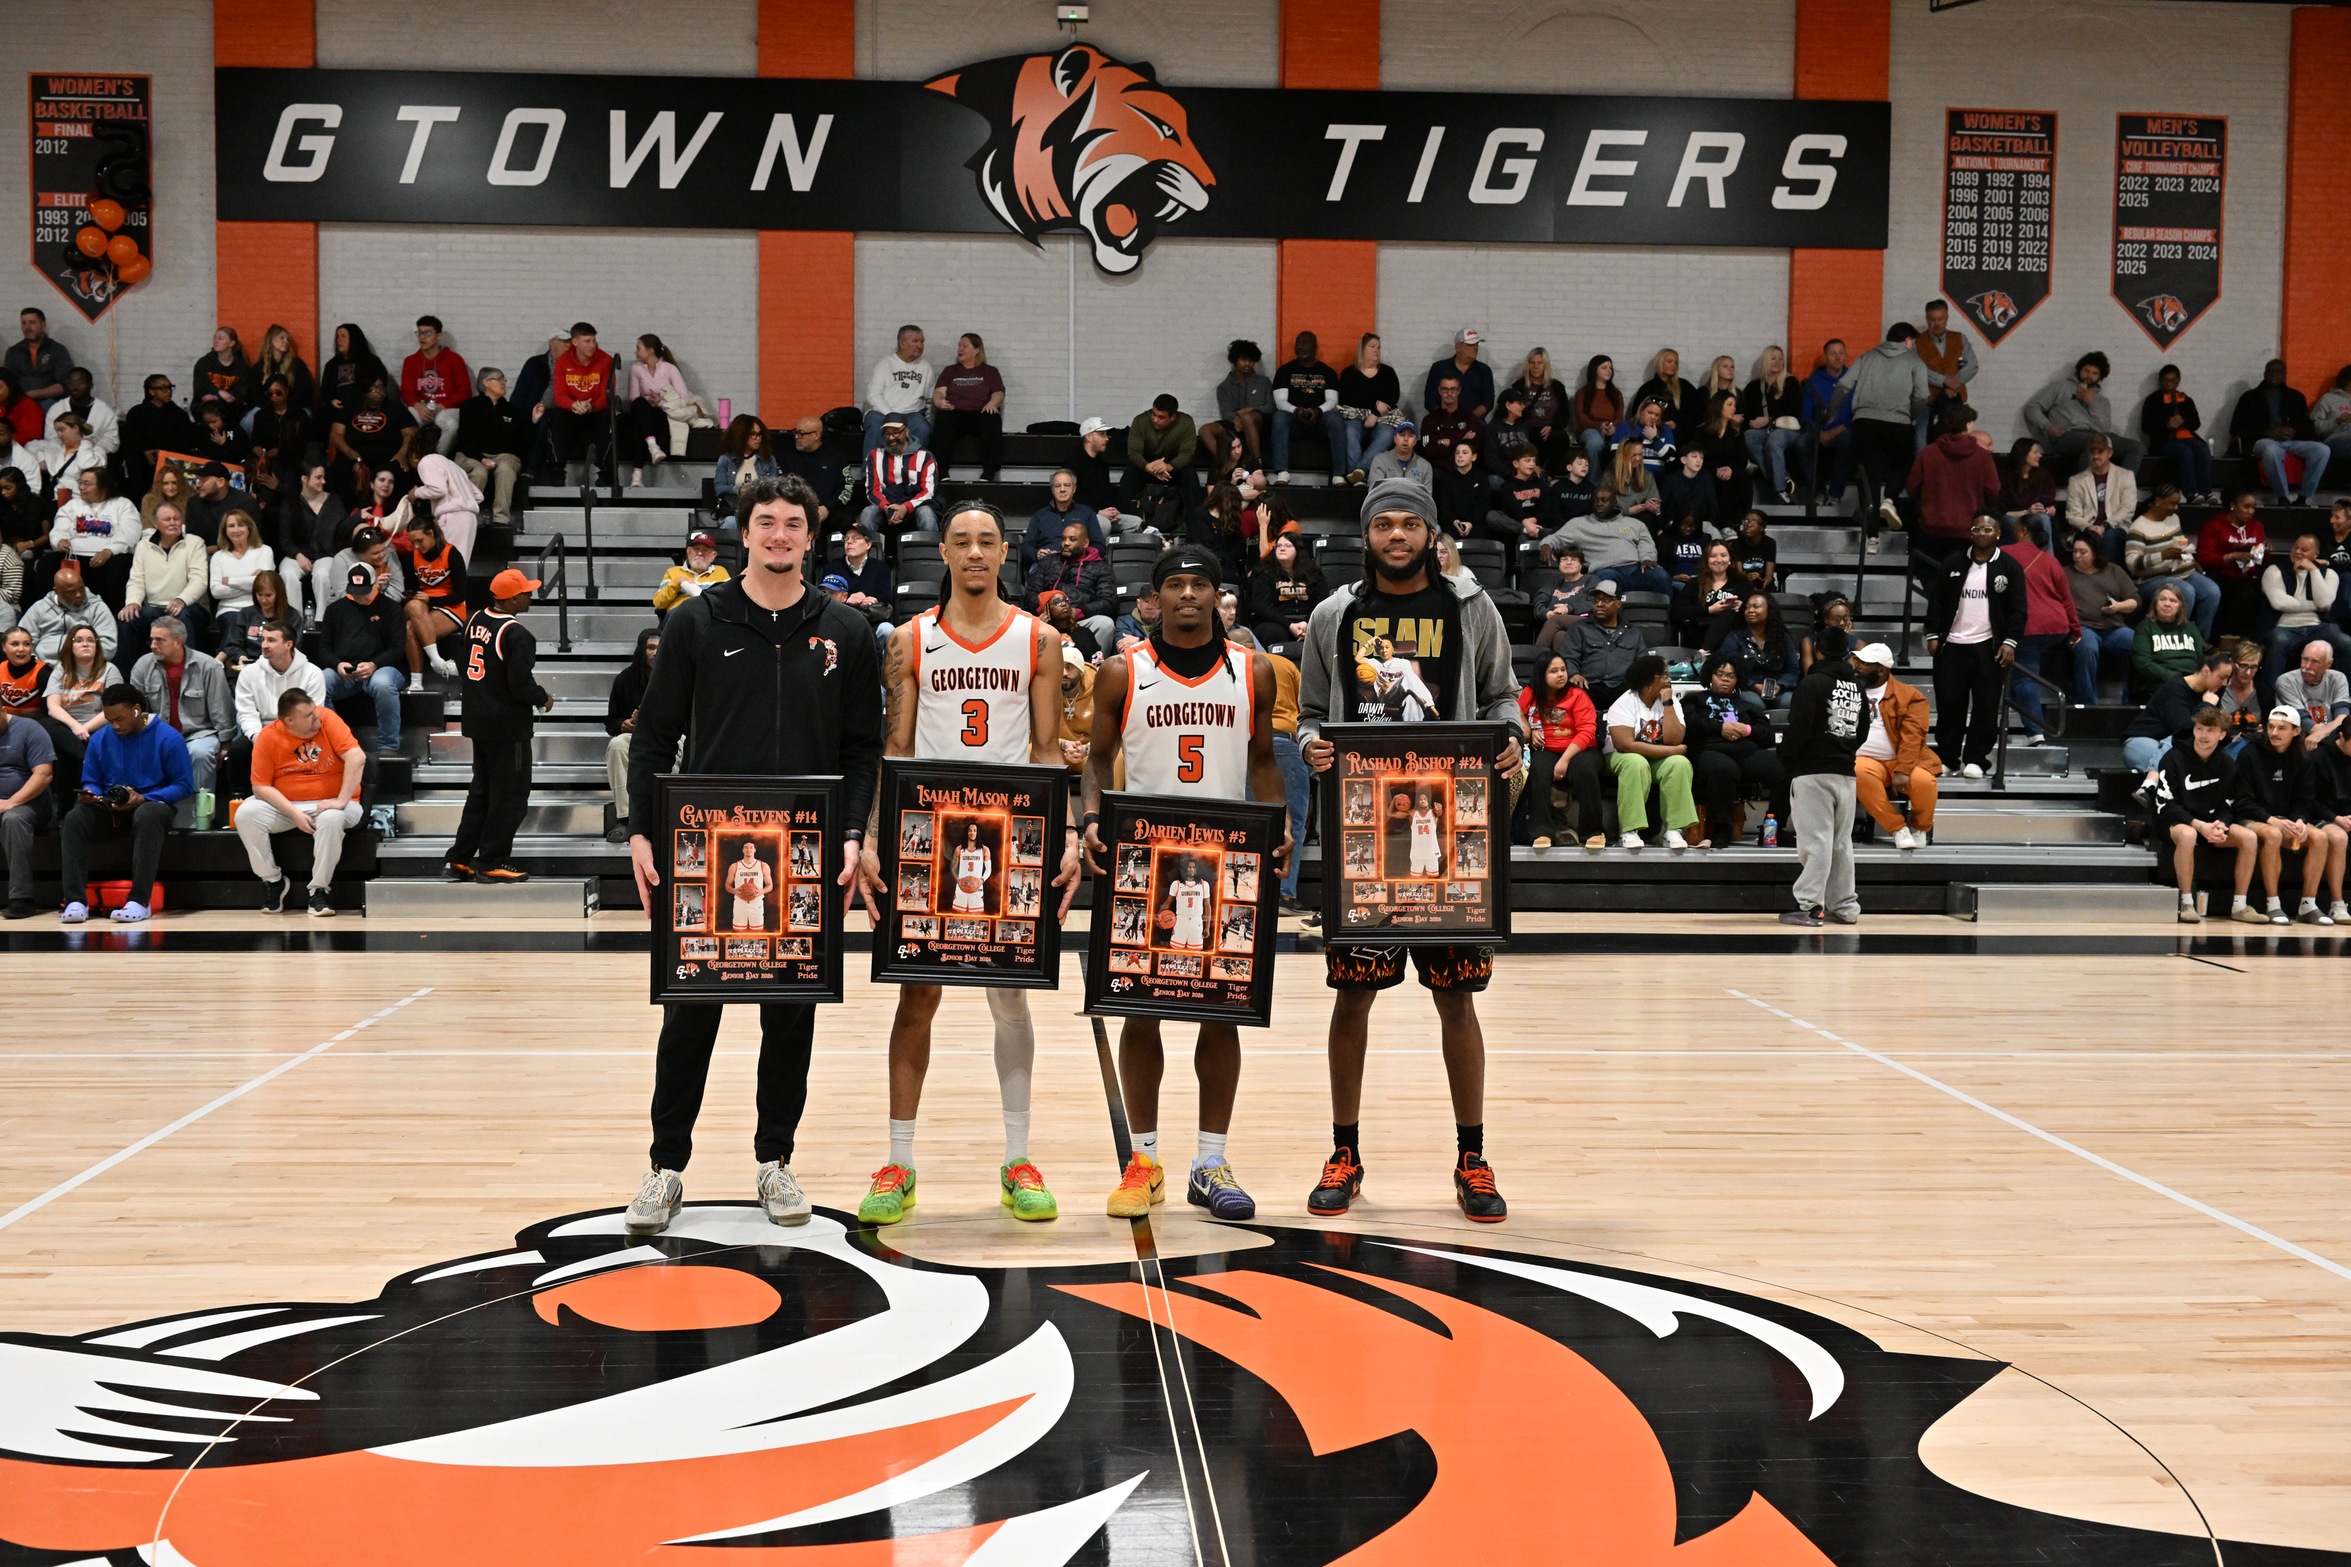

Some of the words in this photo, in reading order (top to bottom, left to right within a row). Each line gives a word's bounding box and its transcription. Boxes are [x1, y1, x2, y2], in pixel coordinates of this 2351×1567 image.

[48, 77, 133, 95] WOMEN'S
[35, 102, 147, 119] BASKETBALL
[1963, 112, 2041, 131] WOMEN'S
[2147, 118, 2198, 136] MEN'S
[54, 123, 91, 136] FINAL
[35, 139, 68, 154] 2012
[1950, 136, 2053, 154] BASKETBALL
[2122, 140, 2221, 159] VOLLEYBALL
[263, 103, 834, 191] GTOWN
[1323, 124, 1848, 209] TIGERS
[1955, 156, 1992, 170] NATIONAL
[1994, 157, 2045, 171] TOURNAMENT
[2145, 161, 2188, 175] TOURNAMENT
[1951, 171, 1979, 186] 1989
[1986, 172, 2014, 187] 1992
[2021, 173, 2050, 189] 1994
[2120, 176, 2149, 191] 2022
[2155, 177, 2184, 192] 2023
[2190, 178, 2219, 193] 2024
[1949, 188, 1978, 203] 1996
[1984, 189, 2014, 204] 2001
[2019, 190, 2049, 205] 2003
[2119, 193, 2149, 207] 2025
[37, 210, 69, 225] 1993
[1948, 205, 1978, 220] 2004
[1983, 206, 2013, 221] 2005
[2019, 207, 2049, 222] 2006
[36, 228, 69, 242] 2012
[1947, 222, 1977, 237] 2008
[1983, 223, 2013, 238] 2012
[2018, 223, 2048, 239] 2014
[2123, 227, 2155, 240] REGULAR
[2155, 228, 2182, 241] SEASON
[2183, 229, 2212, 242] CHAMPS
[1946, 239, 1977, 253] 2015
[1982, 240, 2012, 255] 2019
[2018, 240, 2048, 255] 2022
[2117, 243, 2147, 258] 2022
[2153, 244, 2182, 259] 2023
[2188, 245, 2217, 260] 2024
[1946, 255, 1976, 270] 2023
[1981, 256, 2012, 271] 2024
[2017, 257, 2047, 272] 2025
[2116, 260, 2146, 274] 2025
[893, 370, 923, 384] TIGERS
[1560, 492, 1592, 500] MIAMI
[1676, 543, 1703, 555] AERO
[418, 566, 446, 582] Tigers
[469, 626, 493, 645] LEWIS
[466, 644, 484, 681] 5
[931, 666, 1020, 693] GEORGETOWN
[1836, 679, 1858, 692] ANTI
[0, 683, 30, 699] Tigers
[1832, 688, 1862, 702] SOCIAL
[1357, 702, 1384, 714] DAWN
[1832, 699, 1862, 712] RACING
[1146, 702, 1236, 729] GEORGETOWN
[1837, 708, 1858, 721] CLUB
[961, 699, 989, 747] 3
[1178, 735, 1204, 783] 5
[1346, 752, 1402, 775] RASHAD
[1405, 751, 1455, 774] BISHOP
[1459, 757, 1483, 770] #24
[916, 784, 960, 807] ISAIAH
[962, 786, 1008, 807] MASON
[1013, 794, 1030, 807] #3
[679, 804, 728, 828] GAVIN
[731, 805, 791, 827] STEVENS
[795, 810, 818, 824] #14
[1135, 818, 1187, 842] DARIEN
[1188, 823, 1225, 844] LEWIS
[1229, 831, 1246, 844] #5
[967, 861, 974, 872] 3
[1187, 897, 1194, 908] 5
[1378, 903, 1425, 913] GEORGETOWN
[1427, 903, 1455, 913] COLLEGE
[1465, 906, 1487, 915] Tiger
[1415, 915, 1429, 923] DAY
[1465, 915, 1486, 923] Pride
[927, 940, 976, 952] GEORGETOWN
[978, 943, 1006, 953] COLLEGE
[1015, 946, 1035, 955] Tiger
[707, 960, 758, 970] GEORGETOWN
[759, 960, 787, 970] COLLEGE
[964, 954, 978, 962] DAY
[1014, 955, 1035, 963] Pride
[797, 963, 819, 972] Tiger
[720, 971, 744, 981] SENIOR
[746, 971, 760, 980] DAY
[1140, 975, 1188, 987] GEORGETOWN
[1190, 978, 1218, 990] COLLEGE
[1177, 990, 1191, 998] DAY
[1227, 983, 1249, 992] Tiger
[1226, 992, 1247, 1000] Pride
